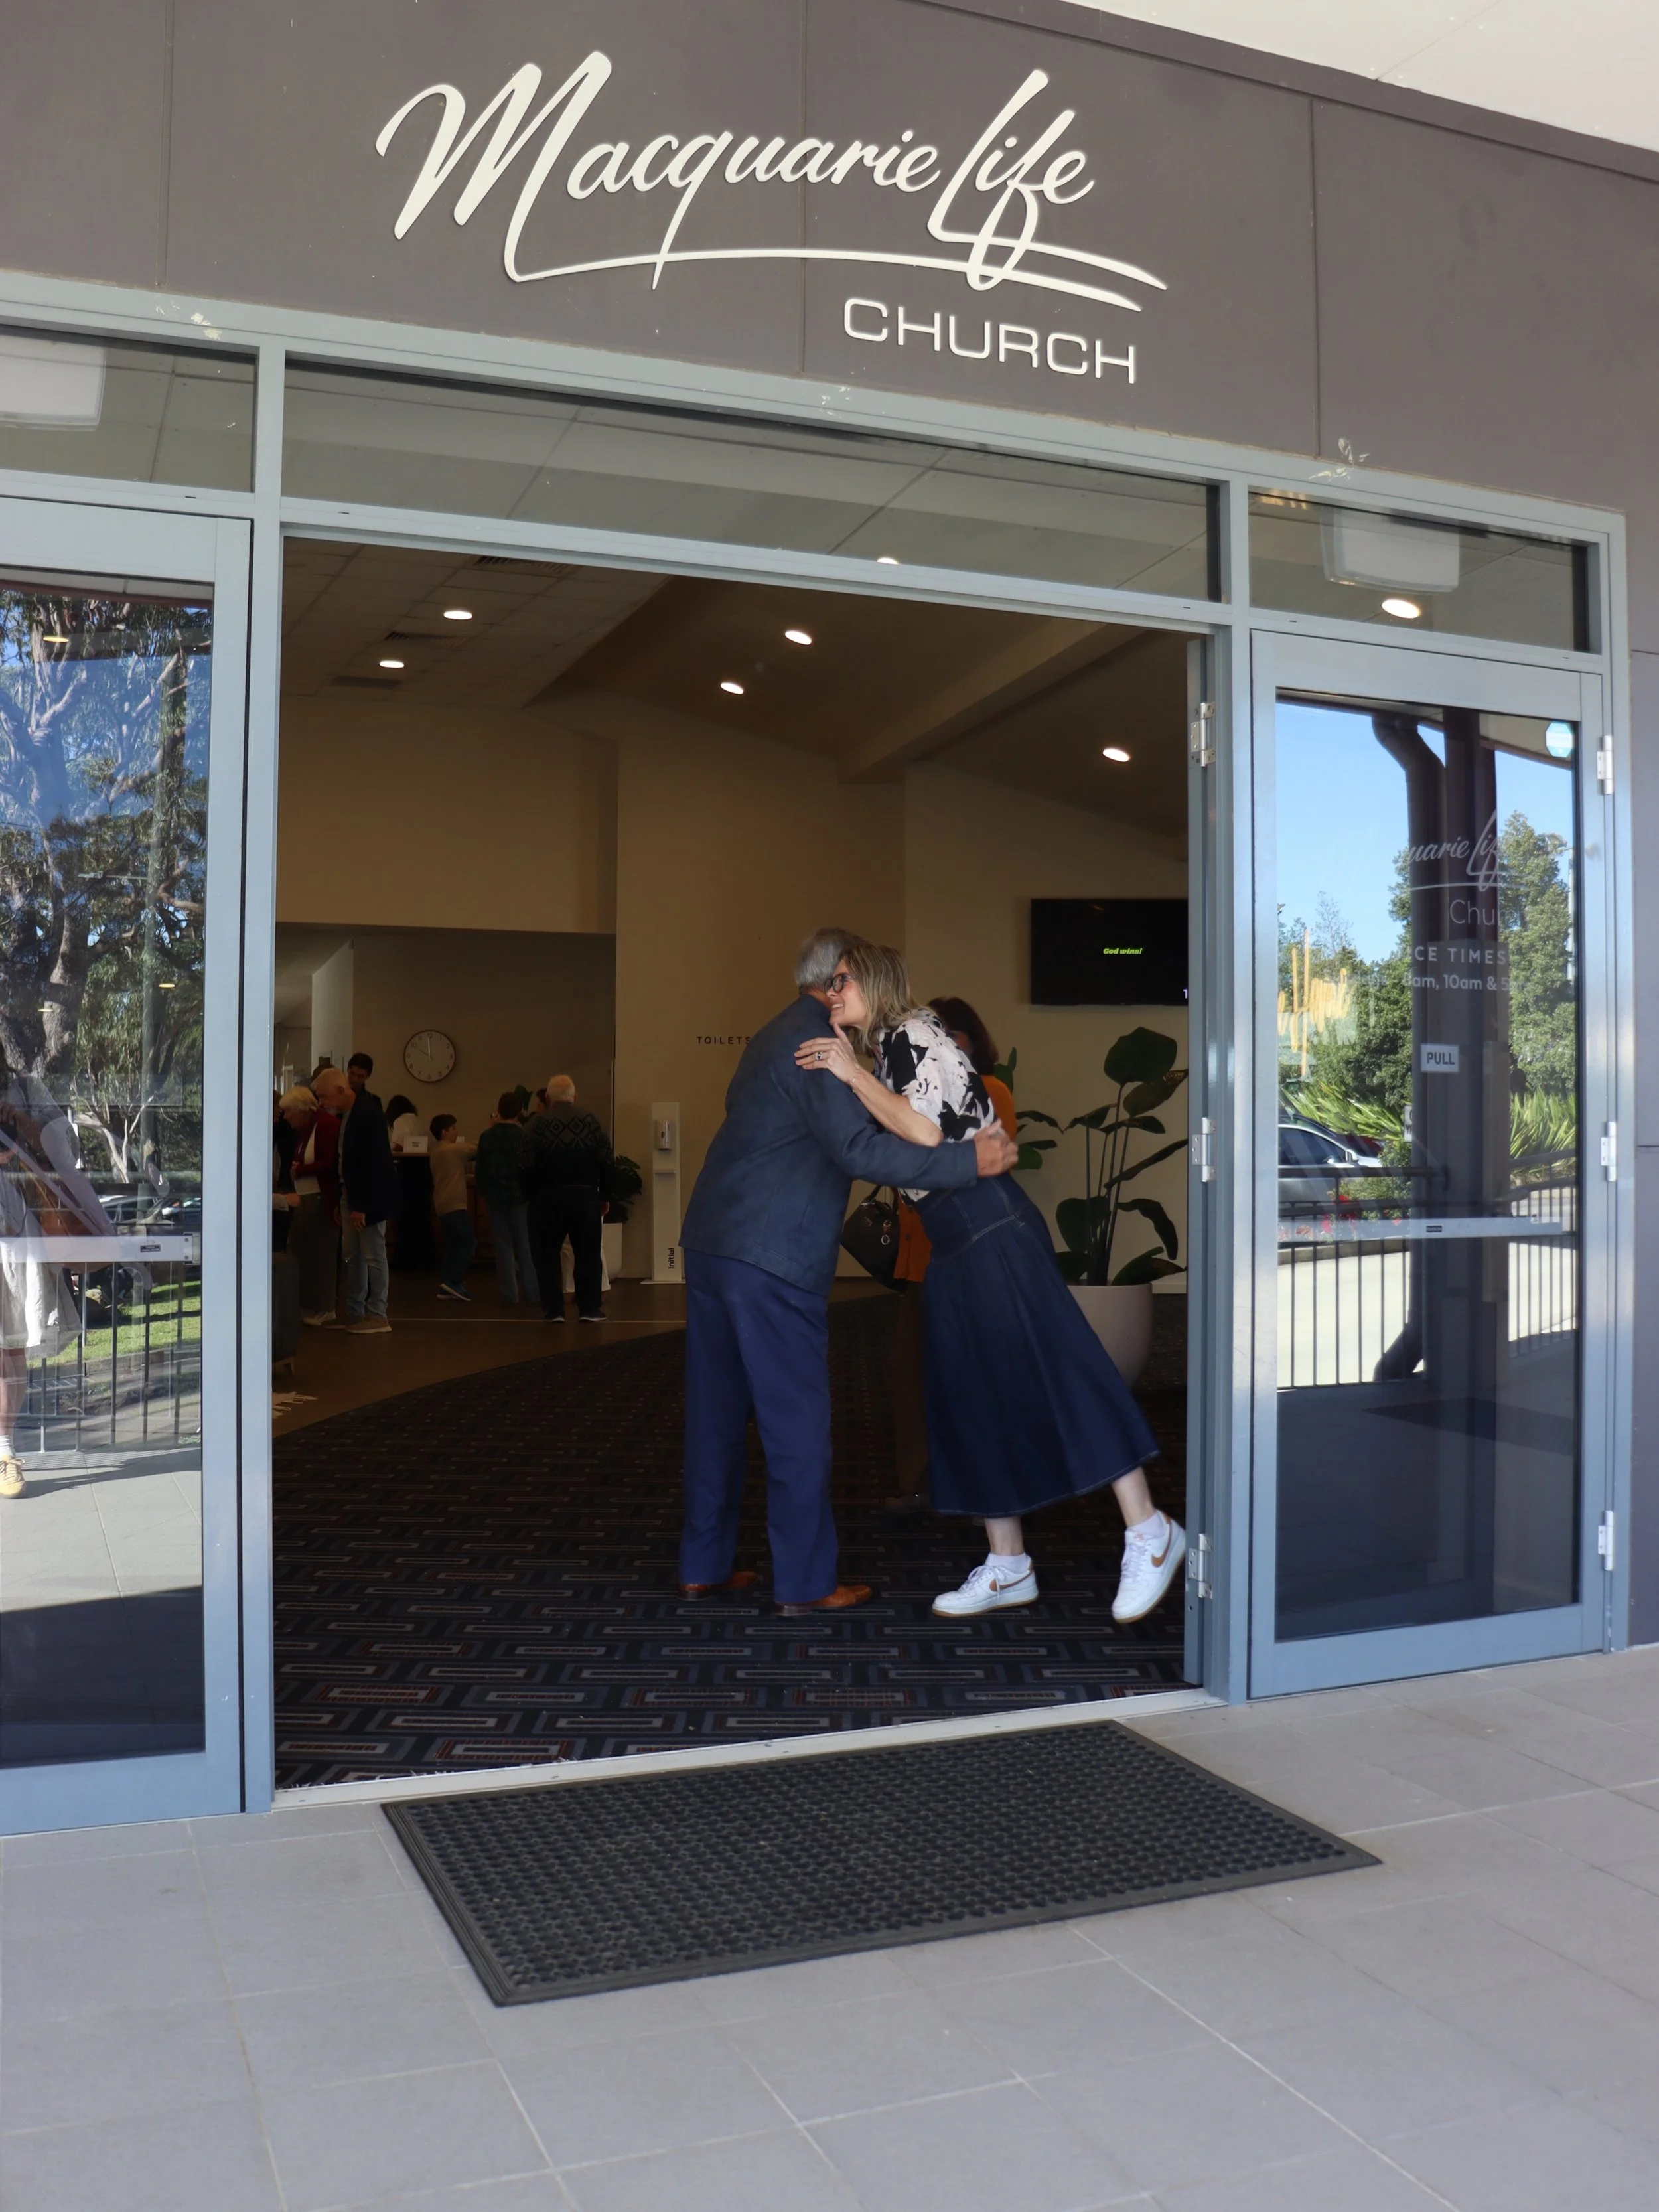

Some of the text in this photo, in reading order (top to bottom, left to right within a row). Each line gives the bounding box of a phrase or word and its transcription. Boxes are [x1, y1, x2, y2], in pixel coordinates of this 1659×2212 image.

[376, 51, 1094, 291] Macquarie Life
[844, 299, 1135, 384] CHURCH
[1466, 808, 1498, 892] Lif
[1450, 899, 1495, 925] Chu
[1447, 948, 1506, 965] TIMES
[1443, 974, 1482, 990] 10am
[1486, 976, 1497, 990] &
[1427, 1052, 1455, 1065] PULL
